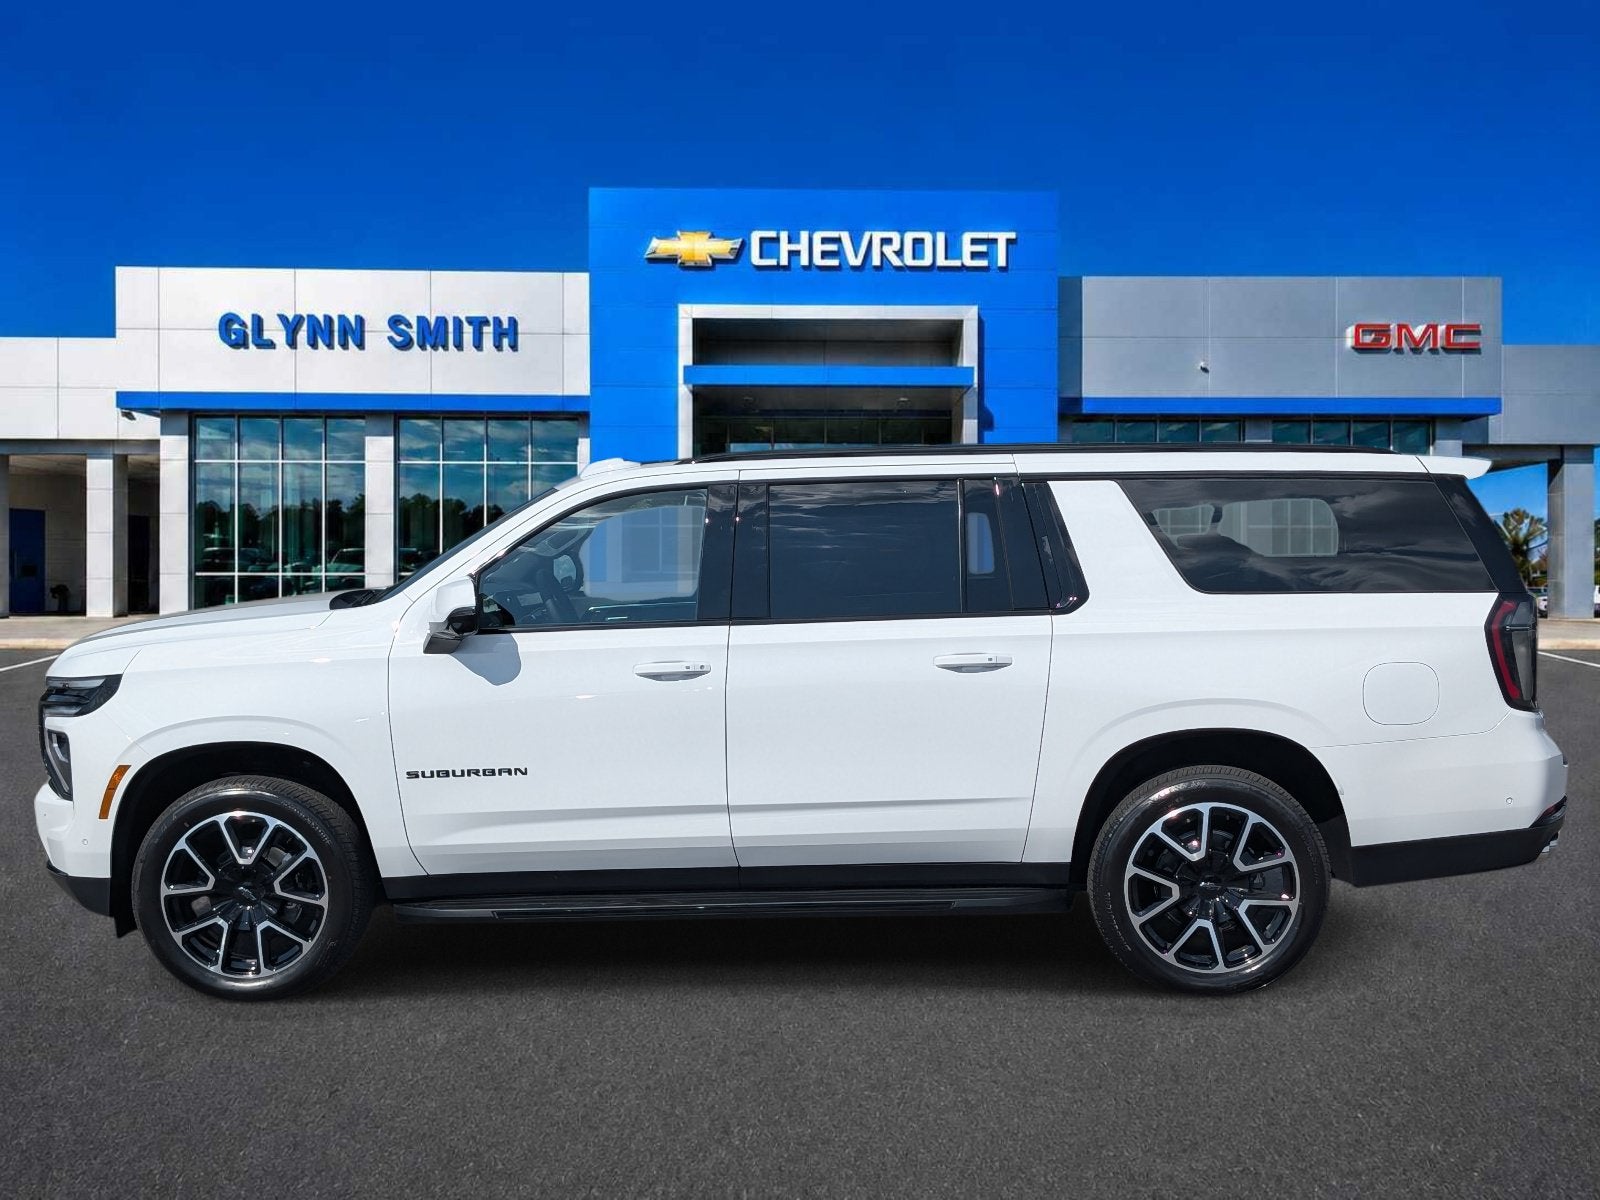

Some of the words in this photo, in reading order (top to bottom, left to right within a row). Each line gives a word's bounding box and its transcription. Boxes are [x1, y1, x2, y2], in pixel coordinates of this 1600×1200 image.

[750, 230, 1017, 268] CHEVROLET
[218, 312, 365, 350] GLYNN
[387, 314, 518, 352] SMITH
[1348, 323, 1482, 352] GMC
[406, 767, 528, 779] SUBURBAN
